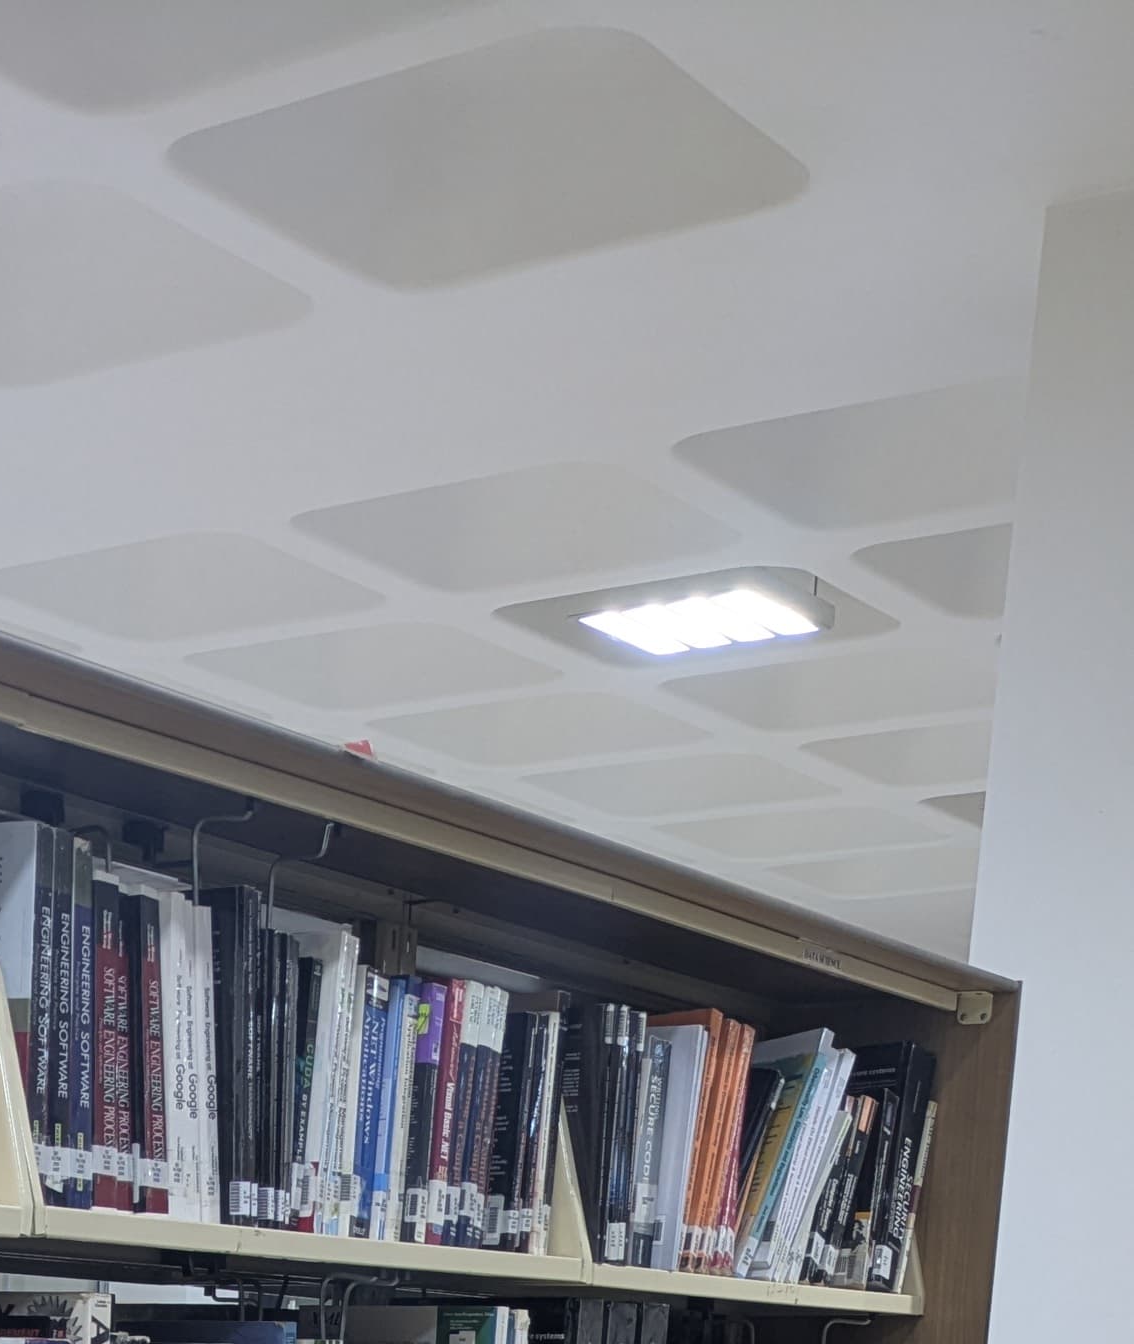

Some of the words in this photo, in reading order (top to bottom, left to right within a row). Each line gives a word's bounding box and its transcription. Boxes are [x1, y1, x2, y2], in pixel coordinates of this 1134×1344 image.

[61, 913, 70, 1014] ENGINEERING
[57, 1021, 68, 1099] SOFTWARE
[206, 1075, 215, 1120] Google
[444, 1111, 452, 1133] Basic
[446, 1082, 454, 1109] Visual
[647, 1075, 658, 1134] SECURE
[440, 1136, 448, 1160] .NET
[893, 1137, 912, 1238] ENGINEERING
[900, 1176, 912, 1242] SECURITY
